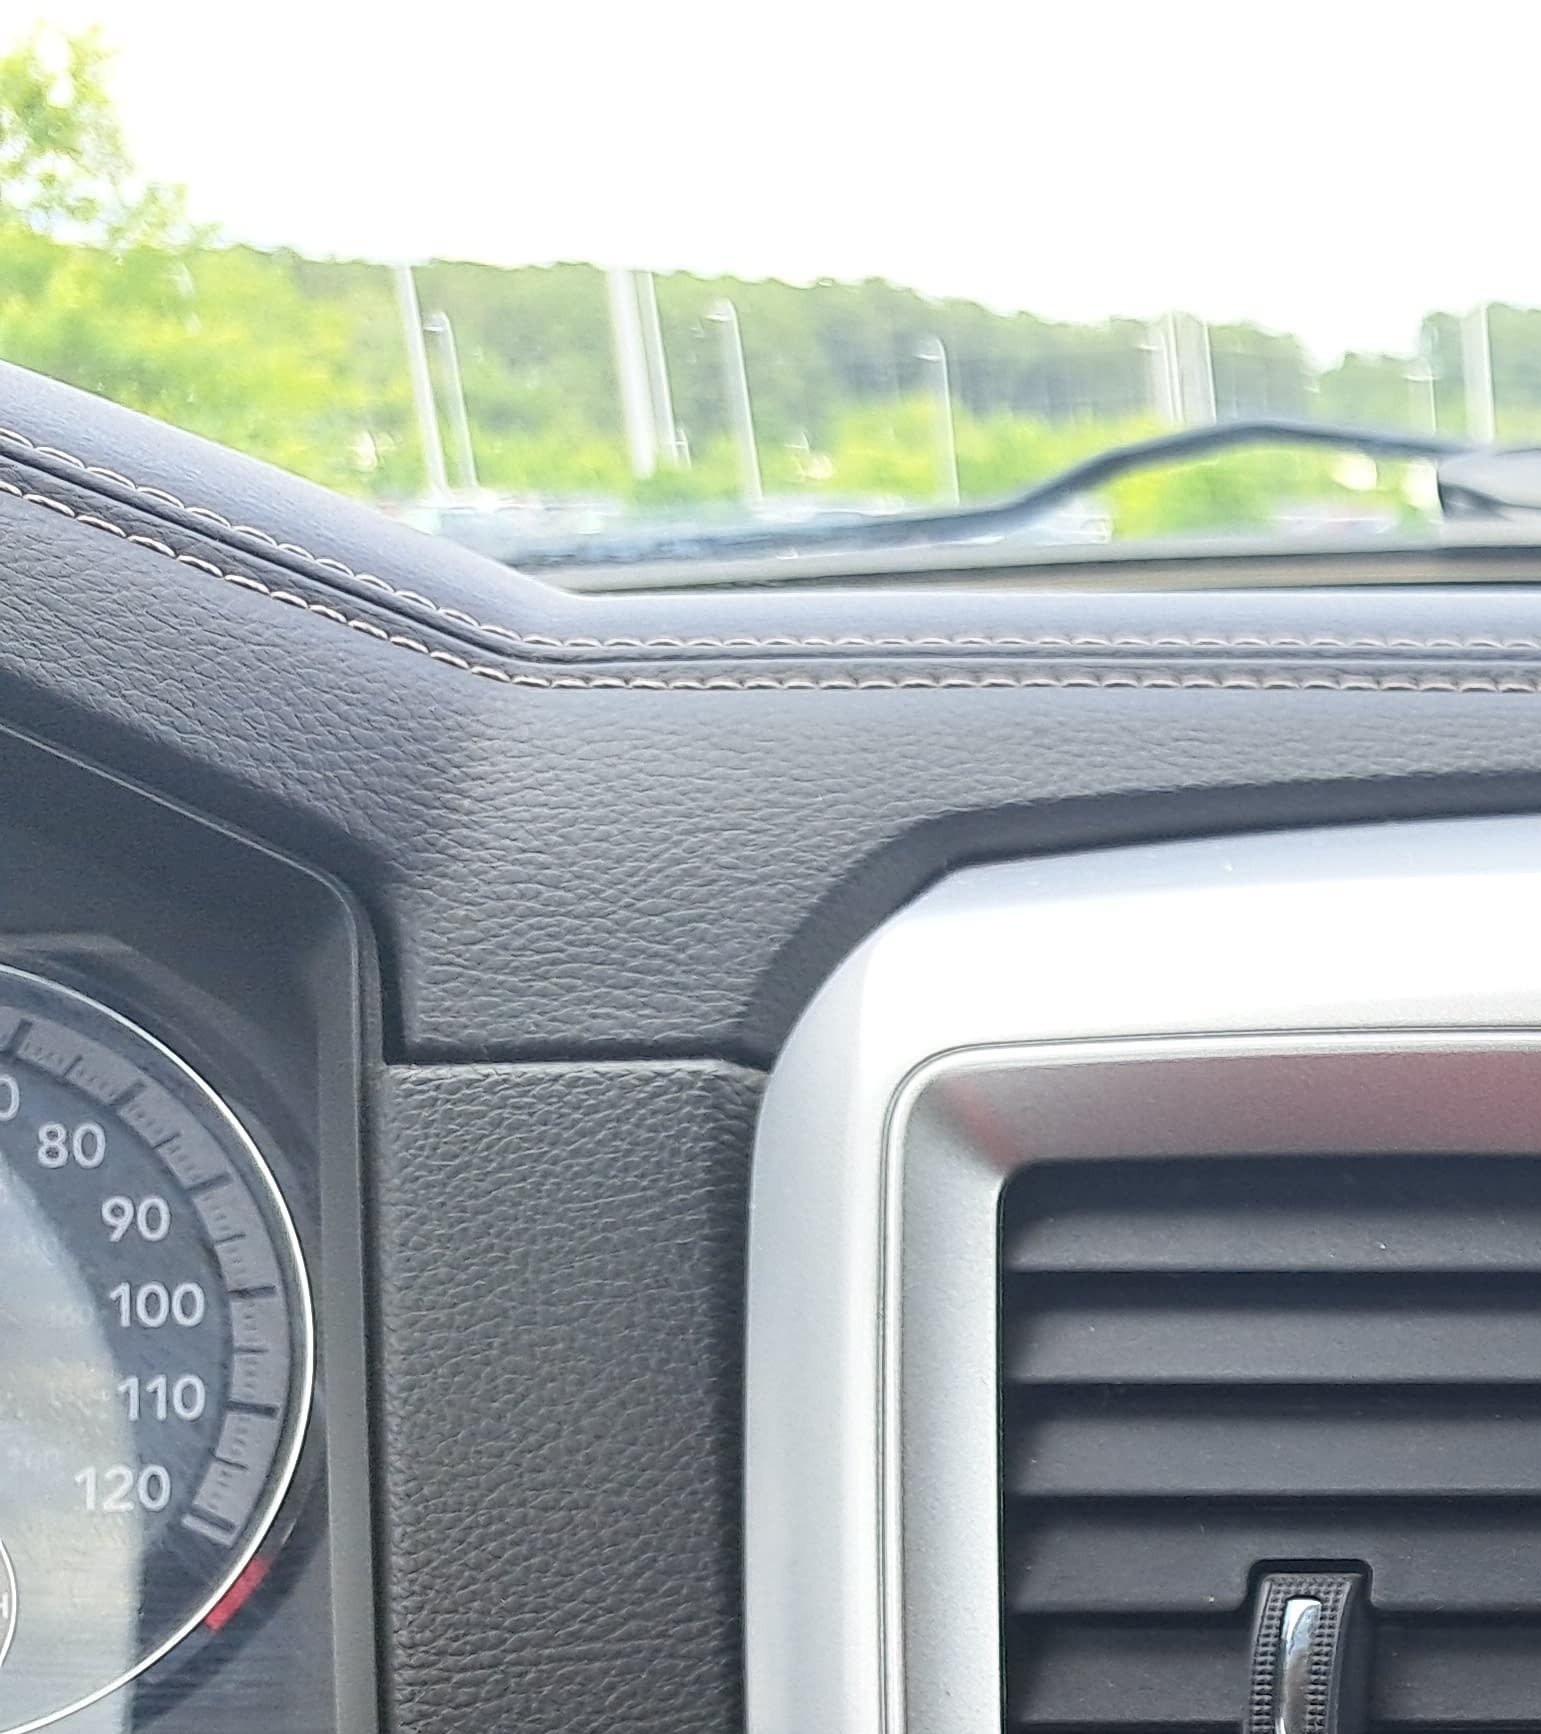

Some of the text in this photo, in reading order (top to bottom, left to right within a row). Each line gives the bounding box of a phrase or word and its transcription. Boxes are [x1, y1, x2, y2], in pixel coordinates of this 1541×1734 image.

[36, 1121, 107, 1170] 80
[101, 1194, 172, 1243] 90
[109, 1282, 205, 1330] 100
[117, 1374, 205, 1422] 110
[74, 1465, 172, 1514] 120
